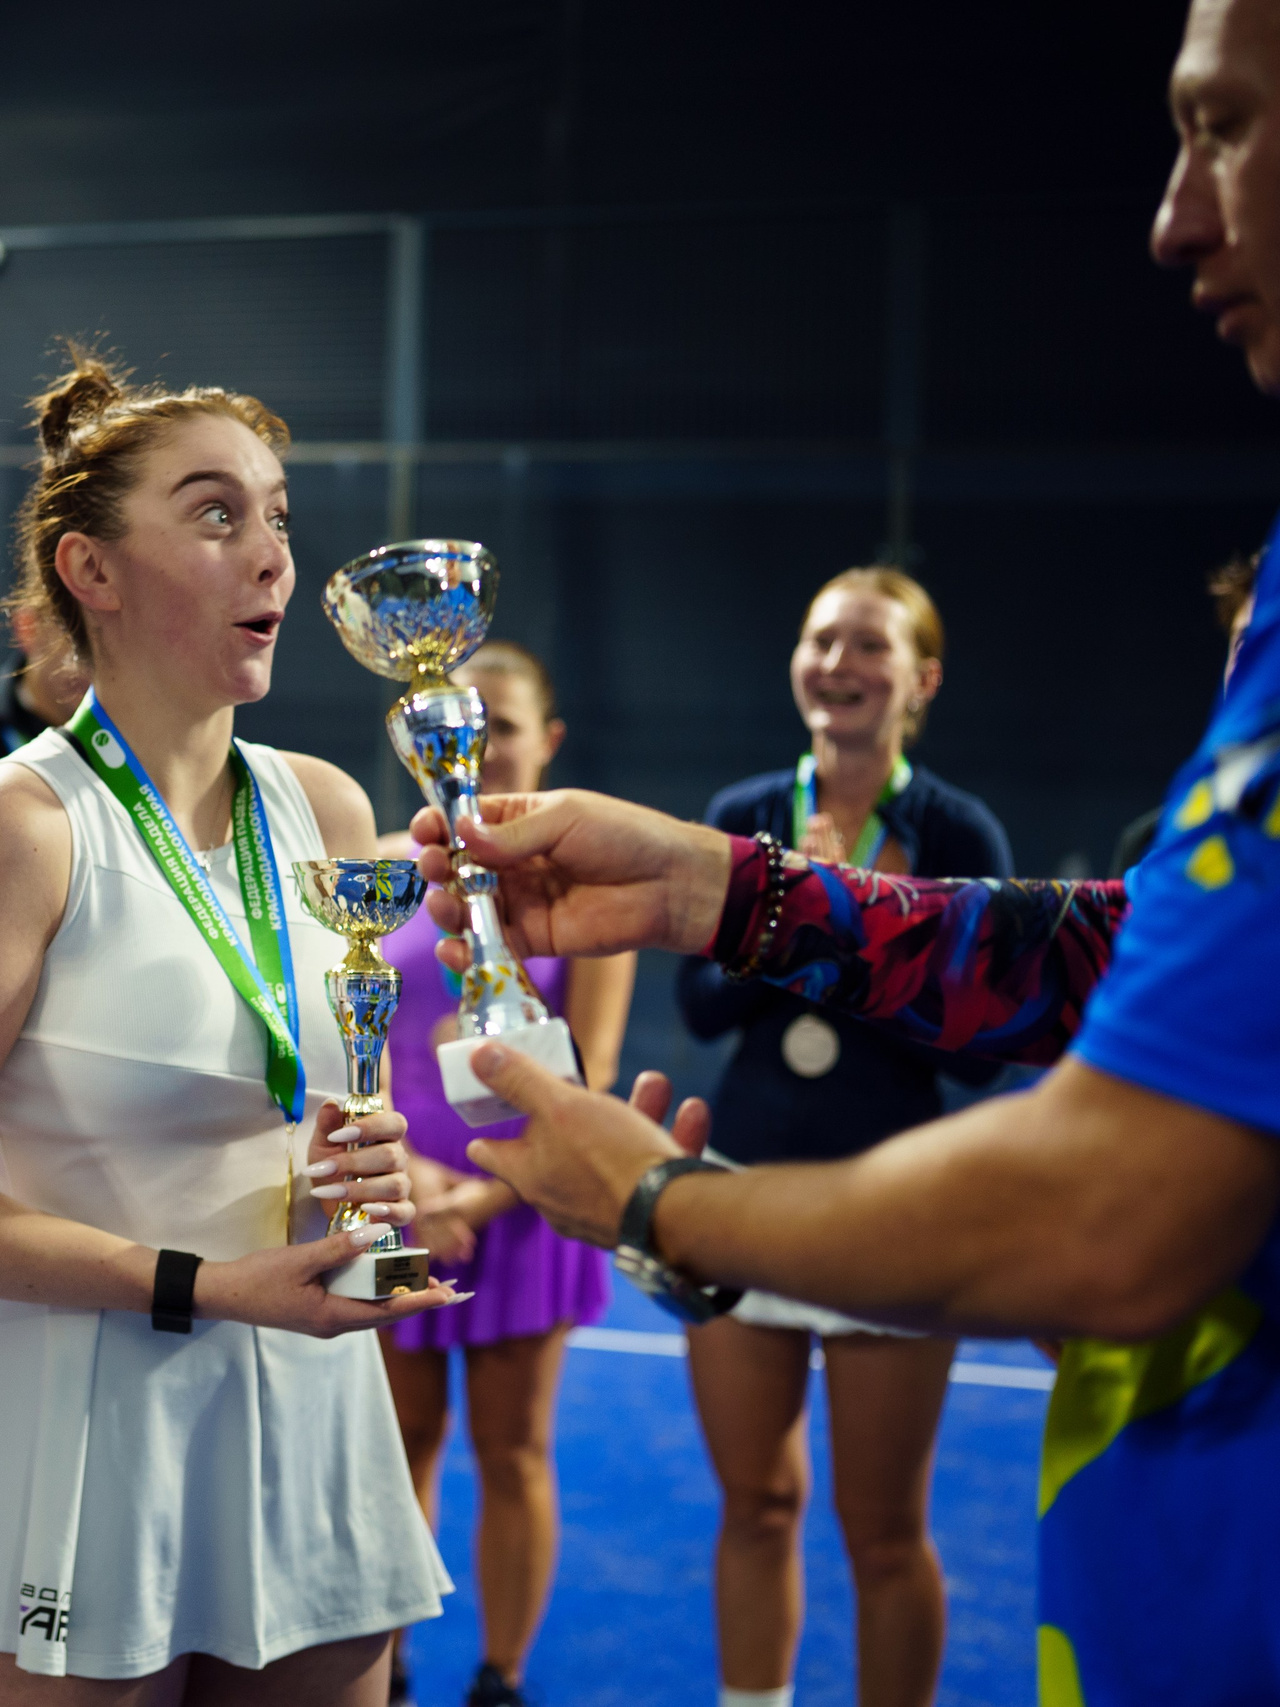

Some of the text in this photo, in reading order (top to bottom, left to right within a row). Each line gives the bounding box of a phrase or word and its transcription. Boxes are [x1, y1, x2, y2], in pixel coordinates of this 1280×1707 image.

[133, 801, 219, 940] ФЕДЕРАЦИЯ ПАДЕЛА
[138, 783, 239, 947] КРАСНОДАРСКОГО КРАЯ
[238, 835, 263, 920] ФЕДЕРАЦИЯ
[248, 800, 282, 931] КРАСНОДАРСКОГО
